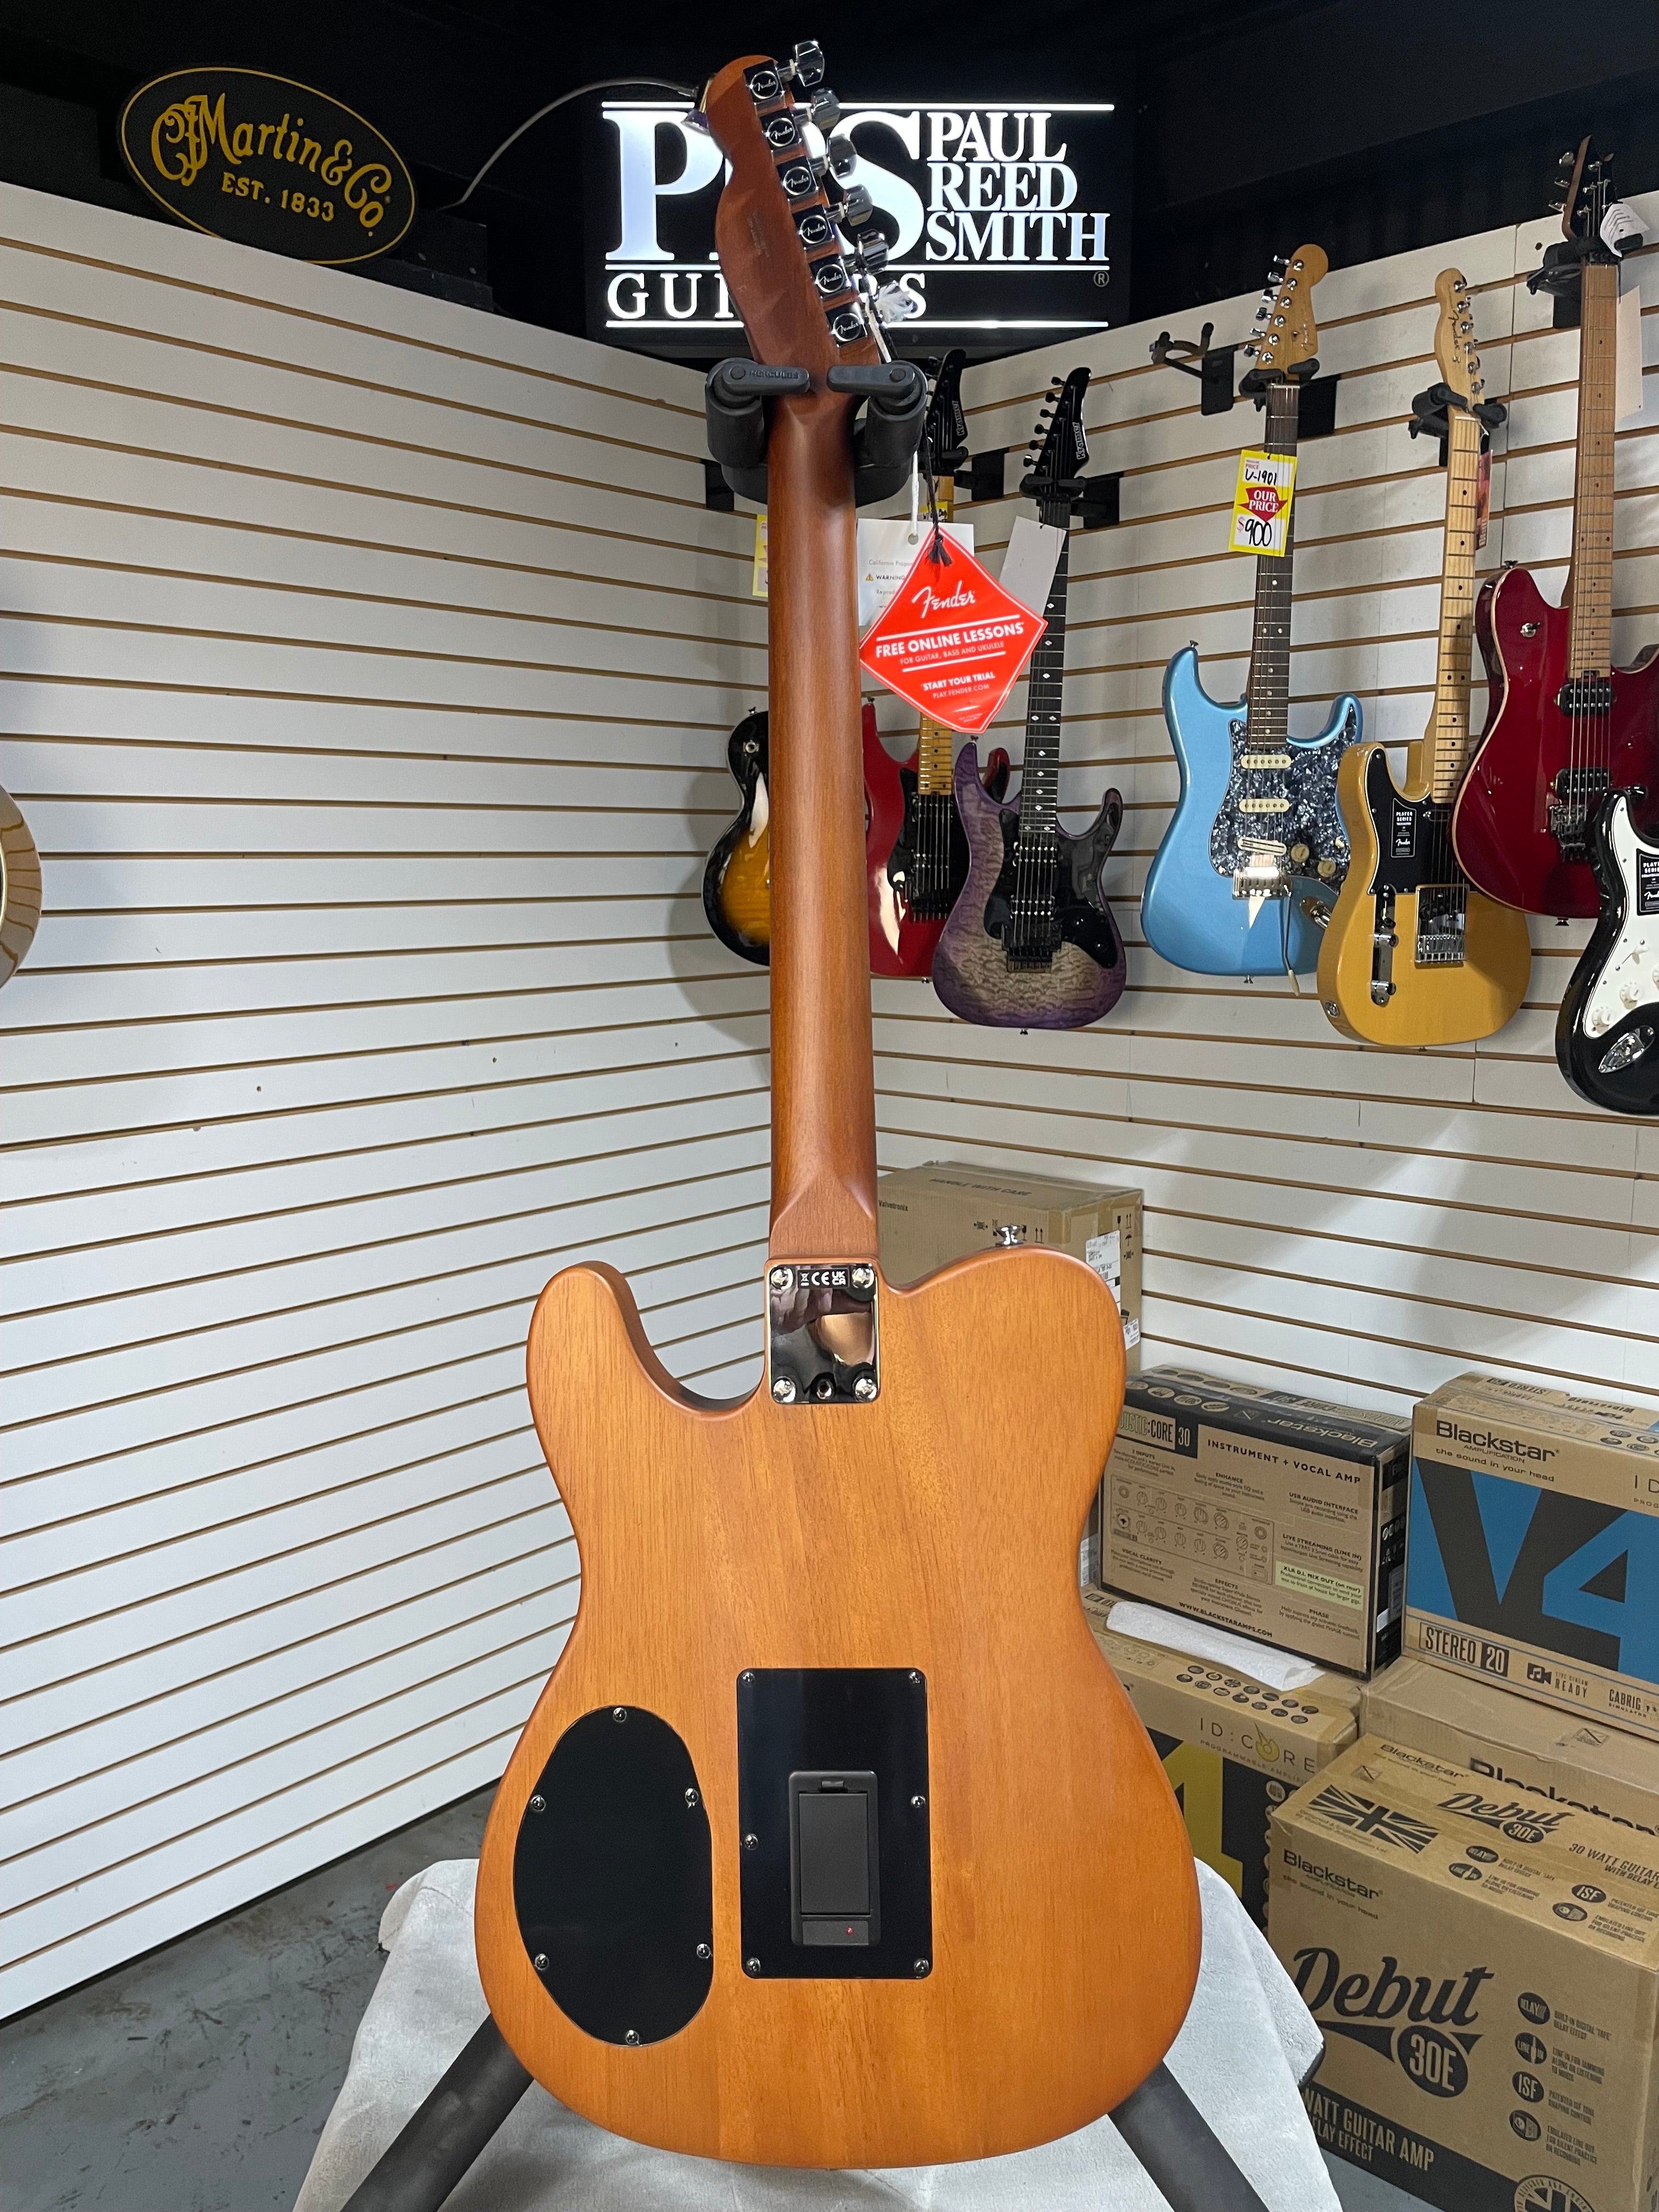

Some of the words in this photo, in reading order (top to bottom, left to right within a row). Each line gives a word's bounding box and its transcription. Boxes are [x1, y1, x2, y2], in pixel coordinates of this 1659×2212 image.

[927, 111, 1068, 162] PAUL
[223, 172, 271, 204] EST.
[281, 189, 334, 222] 1833
[603, 110, 926, 261] PS
[927, 161, 1078, 213] REED
[926, 212, 1110, 262] SMITH
[607, 273, 927, 319] GUIS
[748, 369, 799, 379] HERCULES
[951, 400, 965, 436] Kramer
[1073, 422, 1086, 460] Kramer
[1249, 500, 1279, 513] PRICE
[1254, 490, 1277, 502] OUR
[1237, 517, 1272, 547] $900
[912, 580, 975, 619] Fender
[876, 644, 905, 658] FREE
[907, 631, 961, 652] ONLINE
[900, 657, 913, 665] FOR
[943, 648, 960, 658] BASS
[961, 646, 975, 655] AND
[977, 641, 1005, 652] UKULELE
[933, 683, 990, 699] PLAY.FENDER.COM
[948, 675, 972, 686] YOUR
[973, 671, 996, 681] TRIAL
[1178, 1426, 1190, 1447] 30
[1267, 1419, 1378, 1448] Blackstar
[1436, 1419, 1556, 1462] Blackstar
[1207, 1439, 1279, 1464] INSTRUMENT
[1293, 1460, 1331, 1477] VOCAL
[1335, 1472, 1361, 1483] AMP
[1436, 1448, 1453, 1457] the
[1456, 1453, 1487, 1465] sound
[1489, 1460, 1499, 1469] in
[1502, 1465, 1526, 1475] your
[1529, 1470, 1555, 1482] head
[1463, 1444, 1526, 1464] AMPLIFICATION
[1216, 1472, 1244, 1484] ENHANCE
[1302, 1496, 1323, 1505] AUDIO
[1324, 1501, 1358, 1515] INTERFACE
[1283, 1533, 1295, 1542] LIVE
[1297, 1537, 1333, 1552] STREAMING
[1334, 1548, 1351, 1558] (LINE
[1352, 1552, 1362, 1561] IN)
[1215, 1578, 1238, 1590] EFFECTS
[1320, 1576, 1335, 1584] OUT
[1335, 1581, 1345, 1589] (on
[1179, 1601, 1273, 1638] WWW.BLACKSTARAMPS.COM
[1309, 1609, 1329, 1618] PHASE
[1425, 1627, 1477, 1664] STEREO
[1486, 1646, 1504, 1674] 20
[1554, 1679, 1588, 1699] READY
[1380, 1743, 1465, 1779] Blackstar
[1437, 1792, 1576, 1826] Debut
[1508, 1824, 1539, 1842] 30E
[1569, 1843, 1585, 1854] 30
[1587, 1848, 1620, 1865] WATT
[1283, 1848, 1379, 1899] Blackstar
[1604, 1865, 1626, 1877] WITH
[1627, 1873, 1654, 1887] DELAY
[1283, 1874, 1297, 1884] the
[1300, 1882, 1325, 1897] sound
[1326, 1892, 1335, 1900] in
[1336, 1898, 1356, 1909] your
[1358, 1906, 1379, 1920] head
[1576, 1886, 1601, 1901] ISF
[1293, 1947, 1496, 2026] Debut
[1409, 2033, 1458, 2092] 30E
[1518, 2073, 1538, 2099] ISF
[1338, 2130, 1374, 2162] EFFECT
[1344, 2108, 1396, 2155] GUITAR
[1399, 2137, 1435, 2171] AMP
